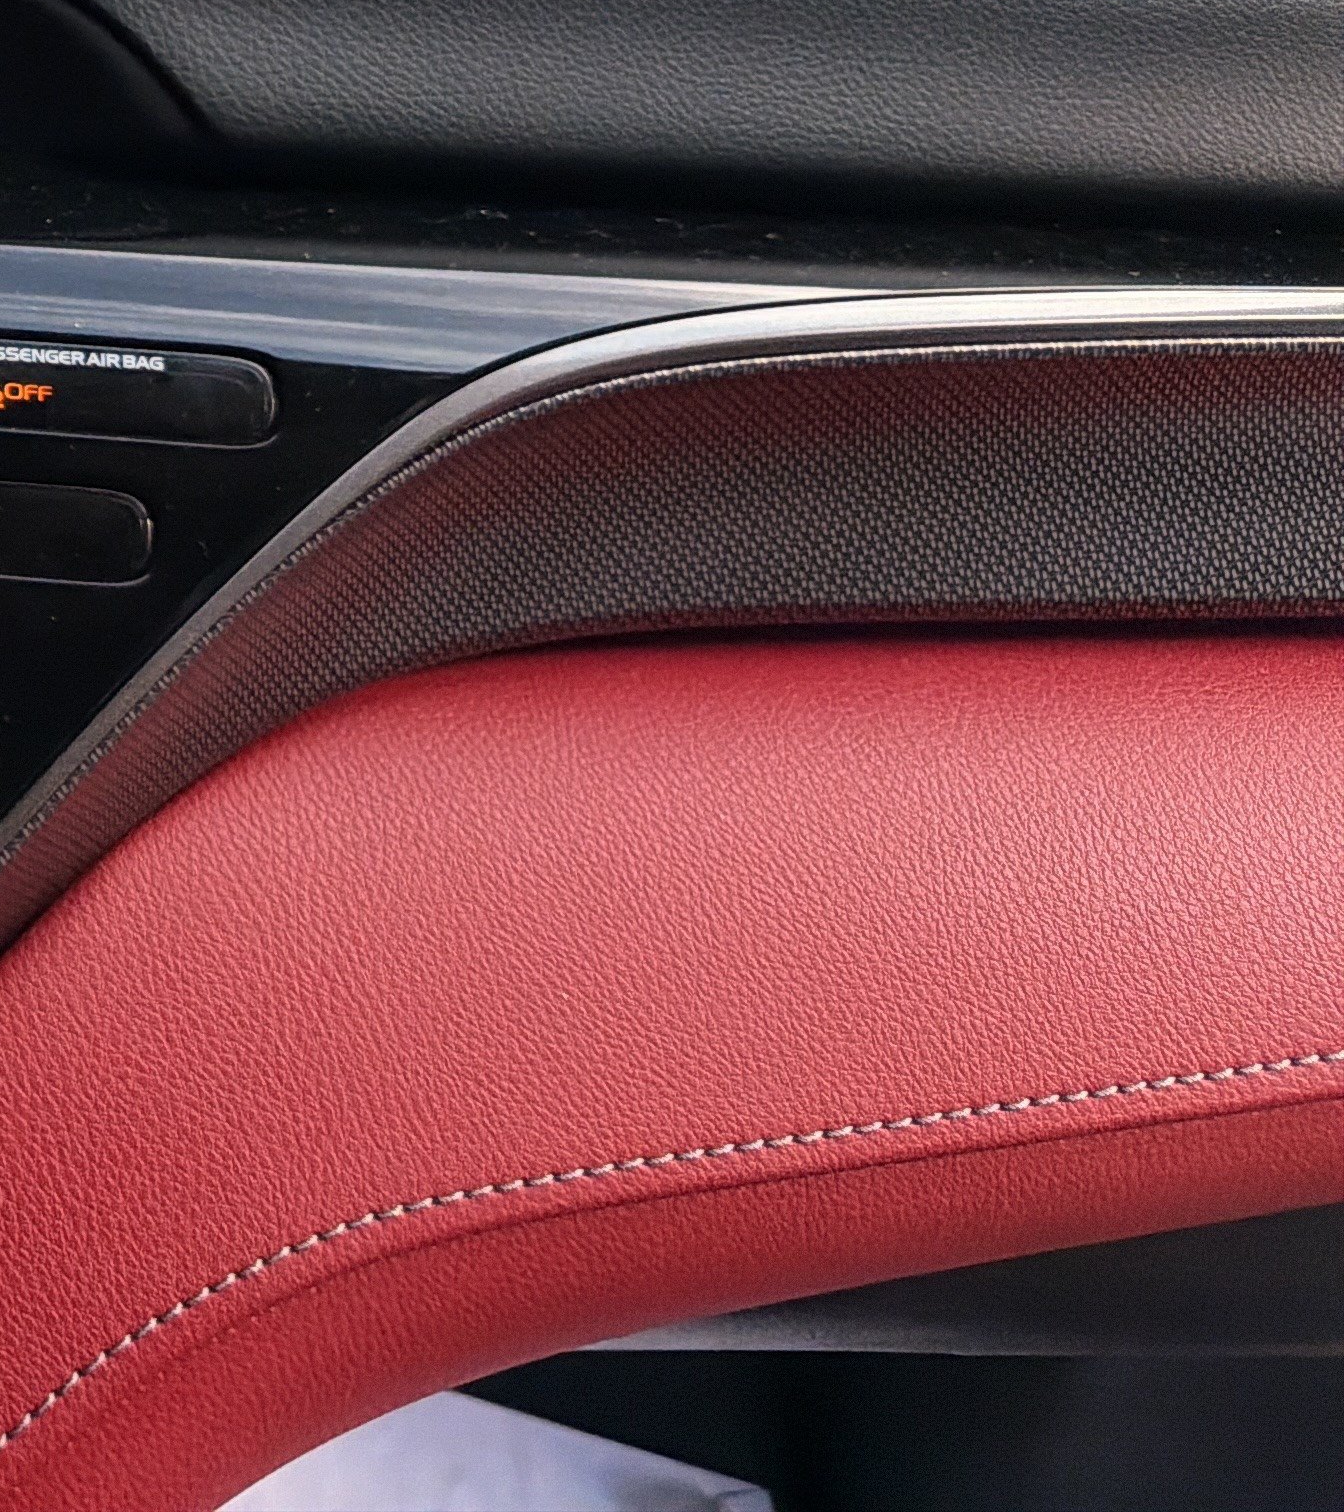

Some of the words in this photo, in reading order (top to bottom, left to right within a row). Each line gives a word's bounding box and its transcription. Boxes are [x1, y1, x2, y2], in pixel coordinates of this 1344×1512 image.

[86, 352, 122, 368] AIR
[122, 354, 166, 371] BAG
[5, 383, 53, 401] OFF
